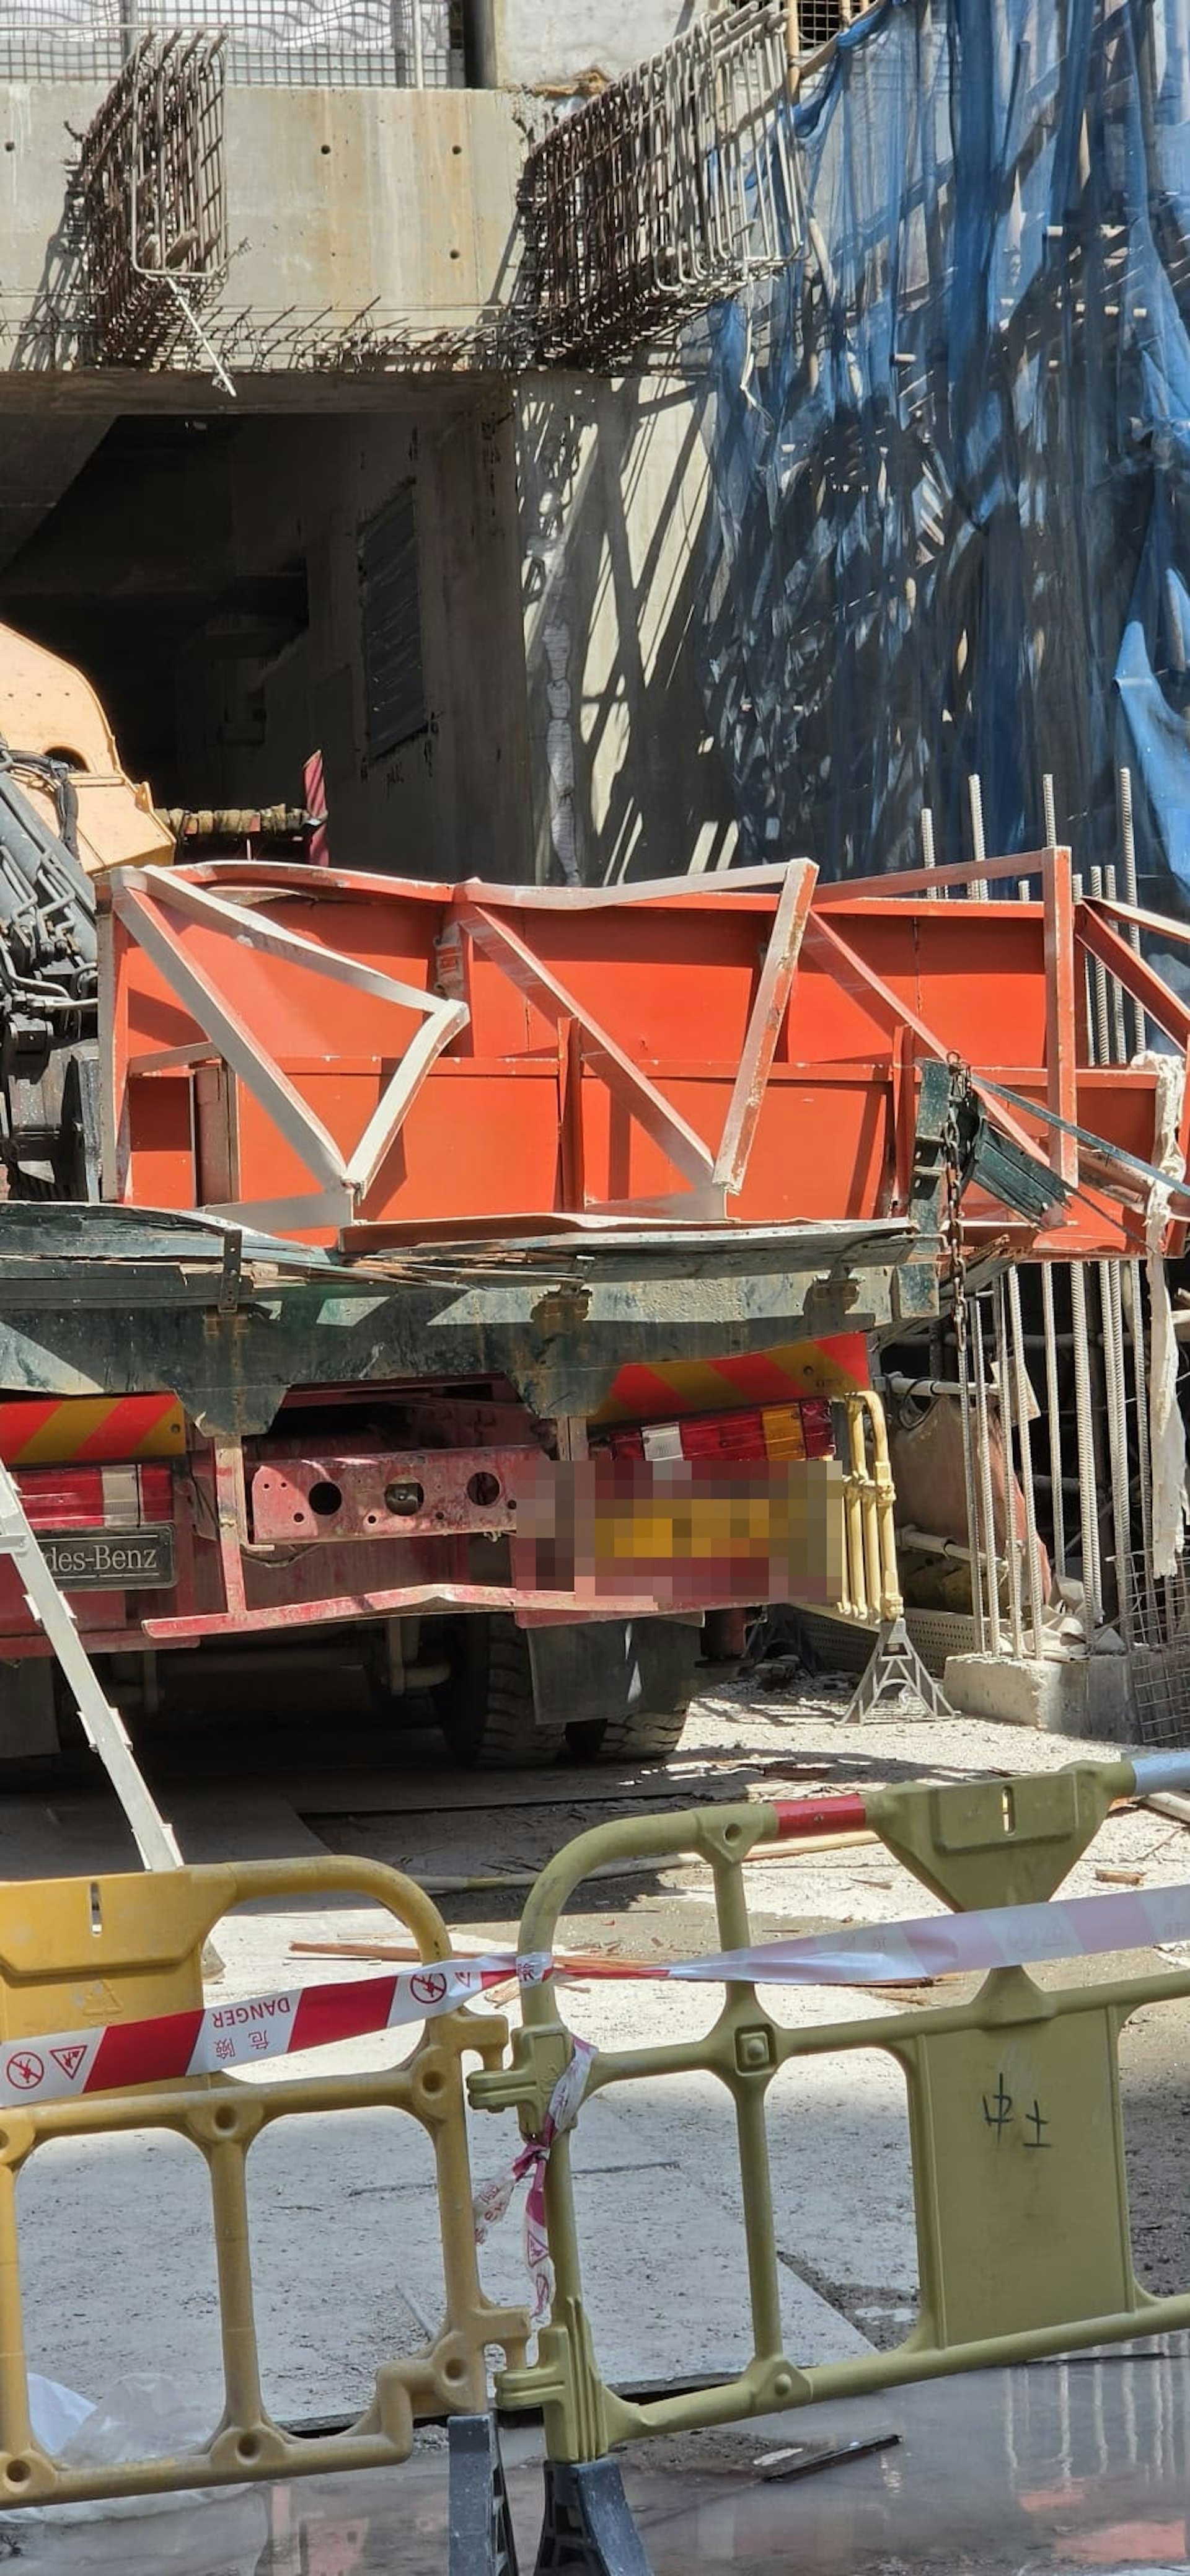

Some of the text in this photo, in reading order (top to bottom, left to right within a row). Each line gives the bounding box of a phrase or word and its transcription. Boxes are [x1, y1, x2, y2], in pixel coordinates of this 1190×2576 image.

[42, 1545, 157, 1572] des-Benz
[212, 1997, 291, 2028] DANGER
[214, 2030, 269, 2059] 危險
